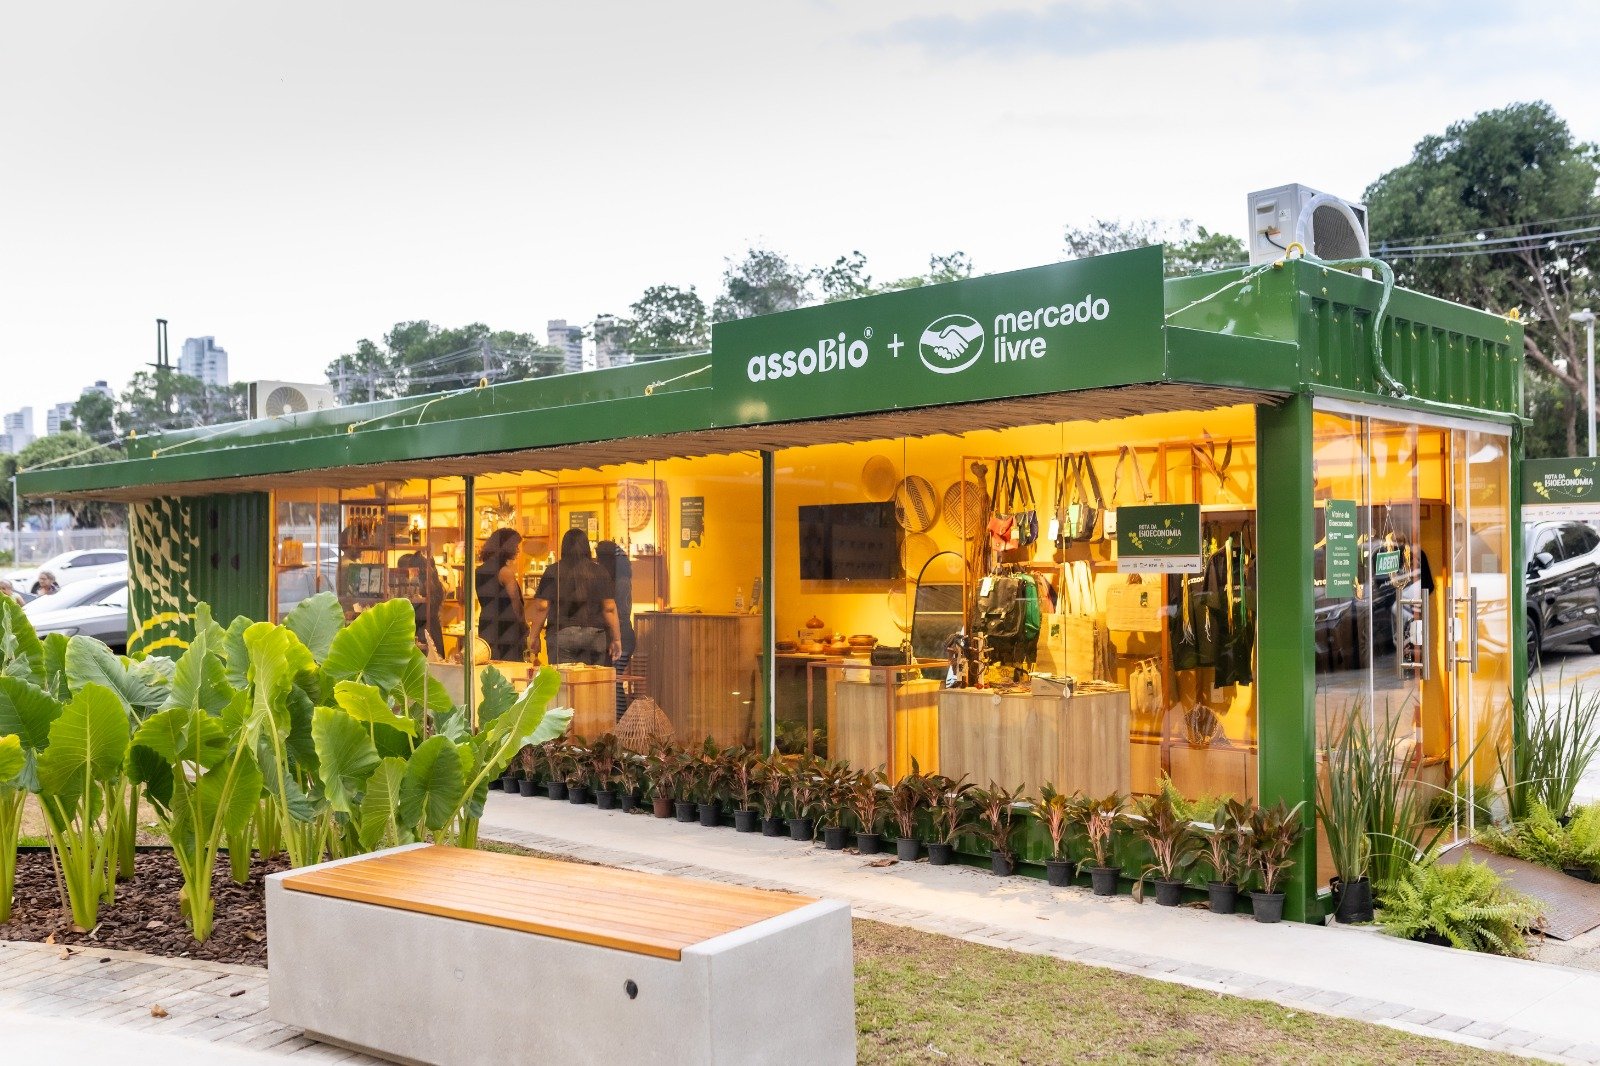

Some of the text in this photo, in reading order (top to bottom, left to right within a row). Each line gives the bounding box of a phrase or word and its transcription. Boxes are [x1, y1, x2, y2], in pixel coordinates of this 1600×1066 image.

[994, 294, 1110, 335] mercado
[994, 334, 1047, 364] livre
[1545, 478, 1593, 487] BIOECONOMIA
[1138, 528, 1182, 538] BIOECONOMIA
